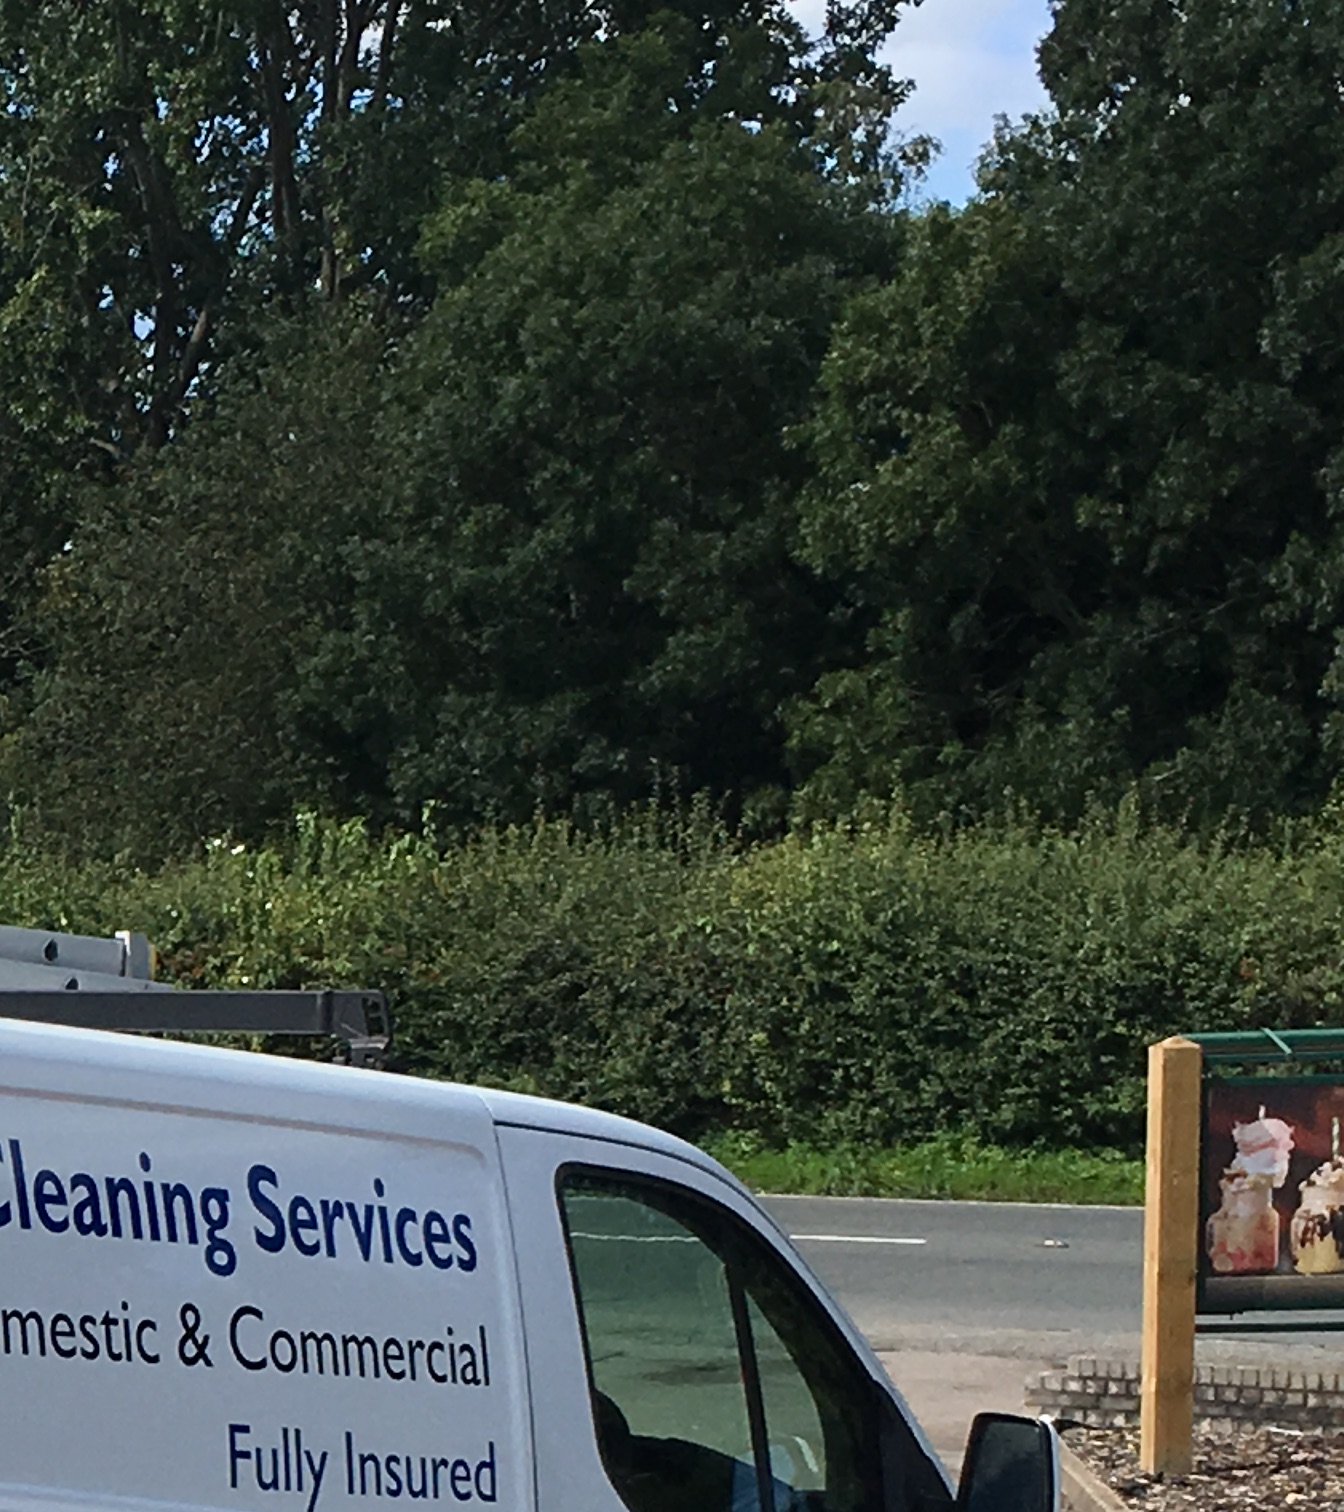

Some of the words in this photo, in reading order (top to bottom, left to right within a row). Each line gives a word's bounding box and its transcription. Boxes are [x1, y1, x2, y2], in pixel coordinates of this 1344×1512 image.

[246, 1164, 478, 1273] Services
[178, 1302, 213, 1368] &
[229, 1305, 491, 1387] Commercial
[228, 1424, 329, 1512] Fully
[345, 1432, 498, 1502] Insured
